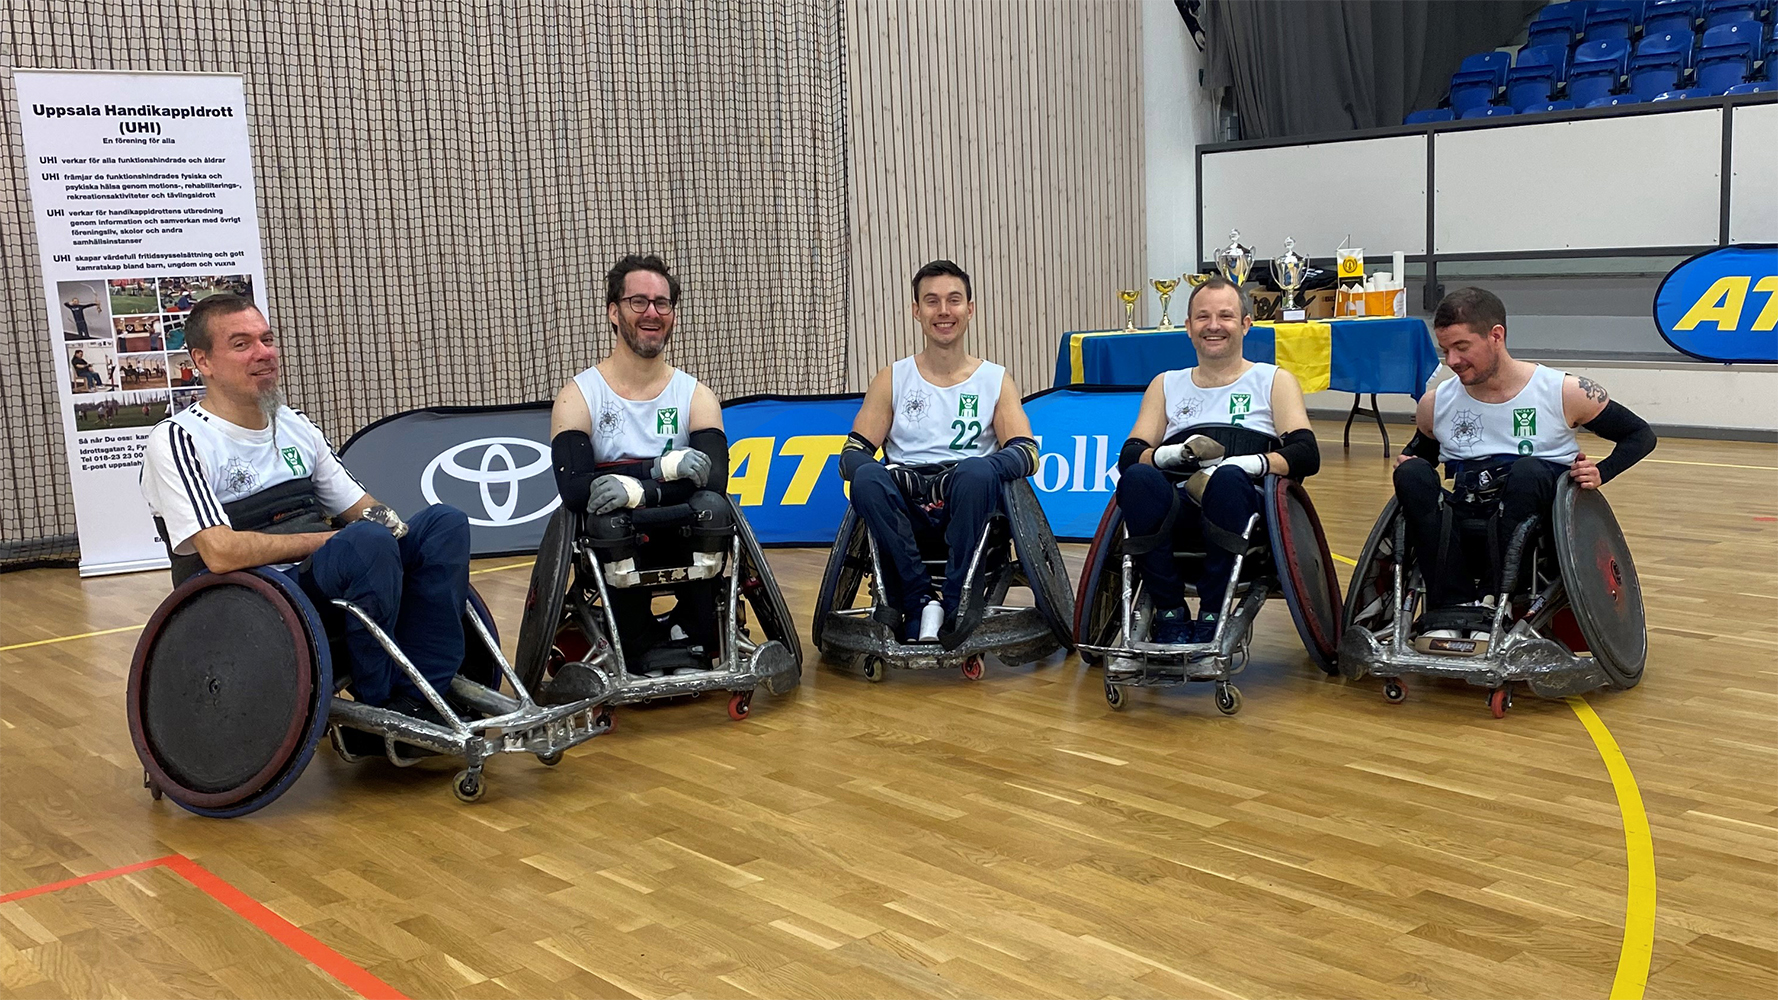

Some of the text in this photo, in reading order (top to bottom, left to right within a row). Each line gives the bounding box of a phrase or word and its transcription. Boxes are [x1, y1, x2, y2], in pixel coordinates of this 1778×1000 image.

[32, 104, 234, 119] Uppsala HandikappIdrott
[119, 122, 161, 135] (UHI)
[39, 156, 57, 164] UHI
[948, 420, 982, 450] 22
[80, 446, 125, 455] Idrottsgatan
[82, 463, 107, 471] E-post
[726, 434, 884, 506] AT
[1032, 434, 1121, 492] olk
